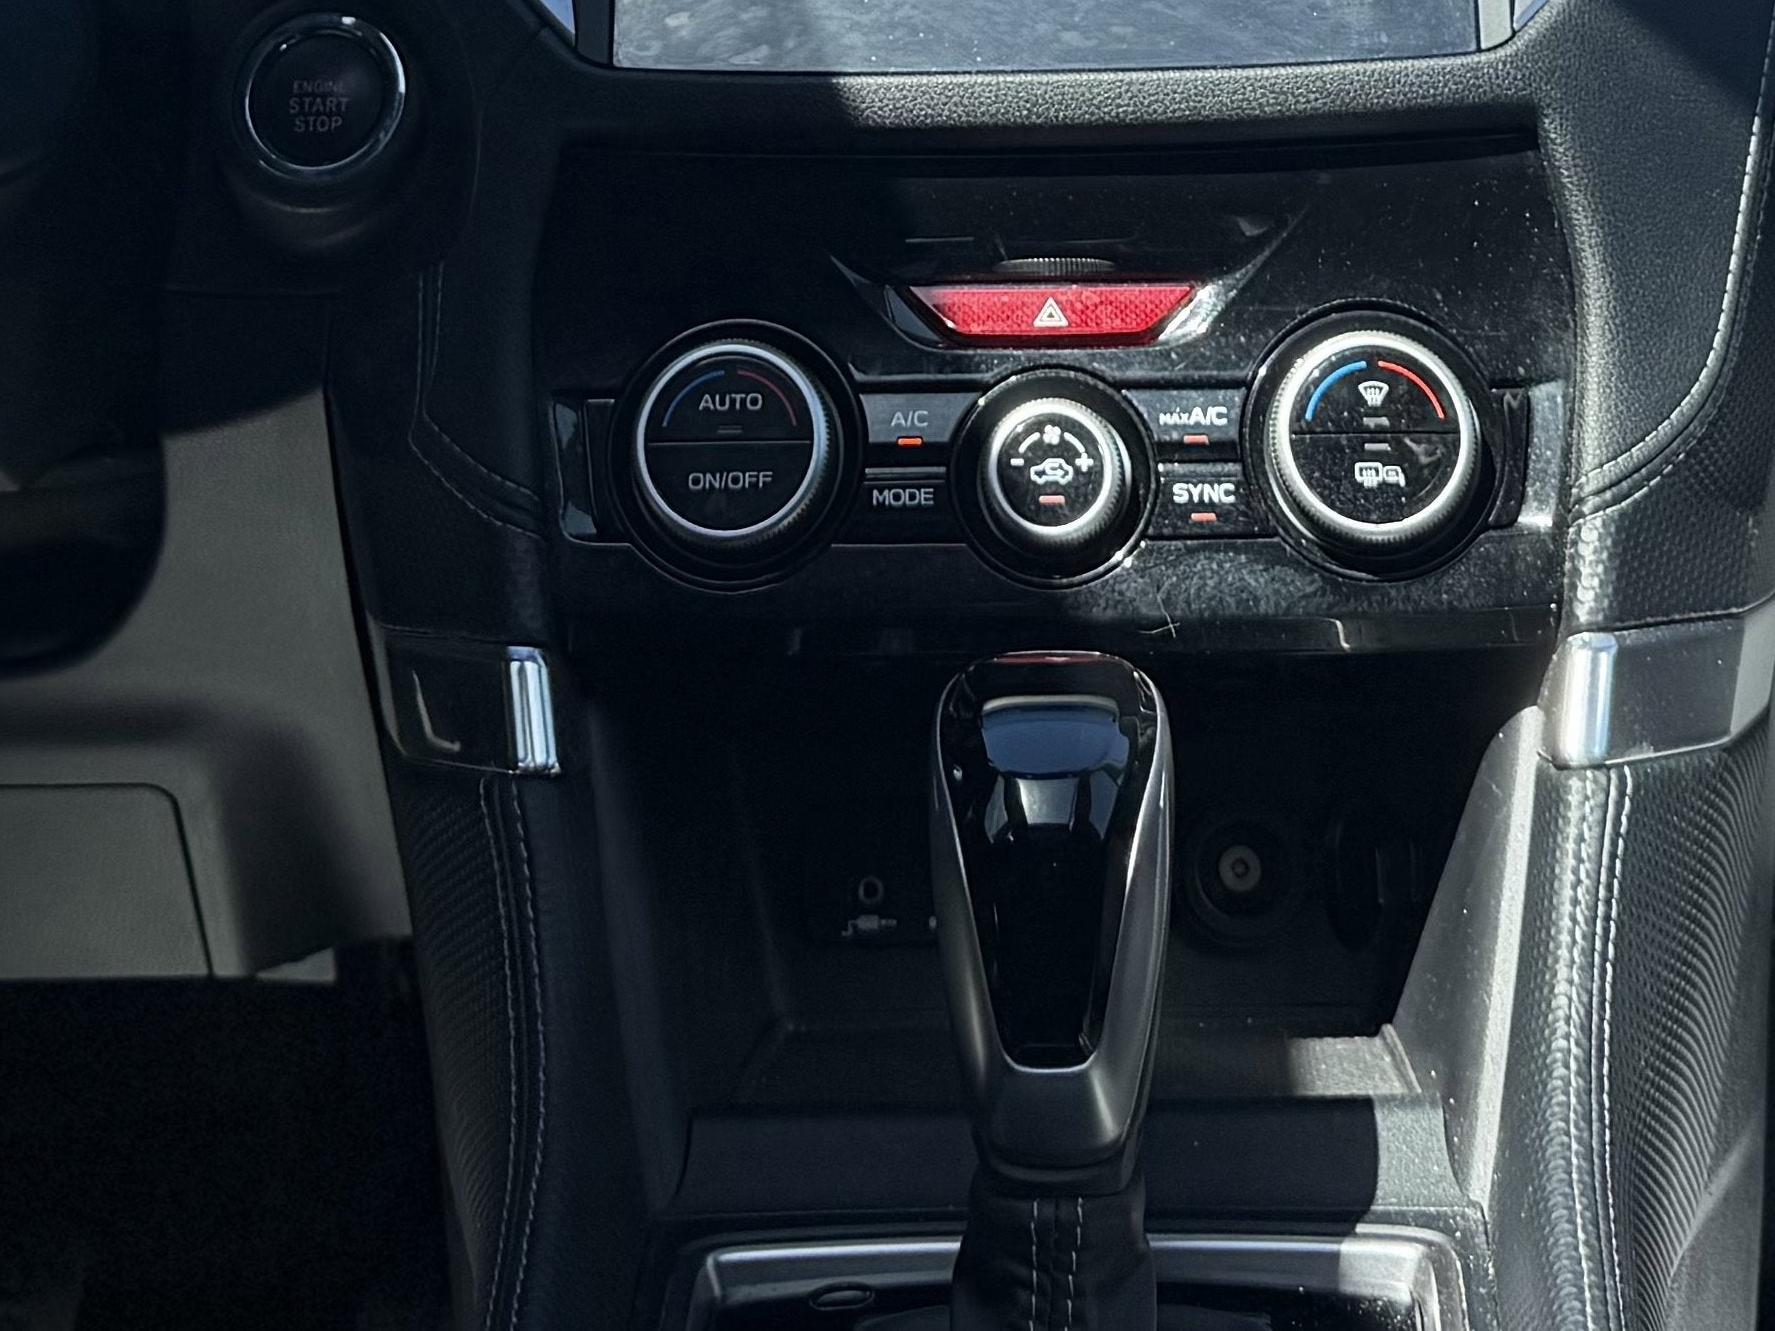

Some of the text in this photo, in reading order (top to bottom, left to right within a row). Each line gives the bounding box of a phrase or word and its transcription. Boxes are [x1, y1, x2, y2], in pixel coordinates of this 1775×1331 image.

[289, 97, 351, 114] START
[294, 116, 343, 132] STOP
[698, 393, 763, 411] AUTO
[890, 410, 929, 427] A/C
[688, 471, 773, 490] ON/OFF
[872, 488, 935, 507] MODE
[1172, 482, 1237, 504] SYNC
